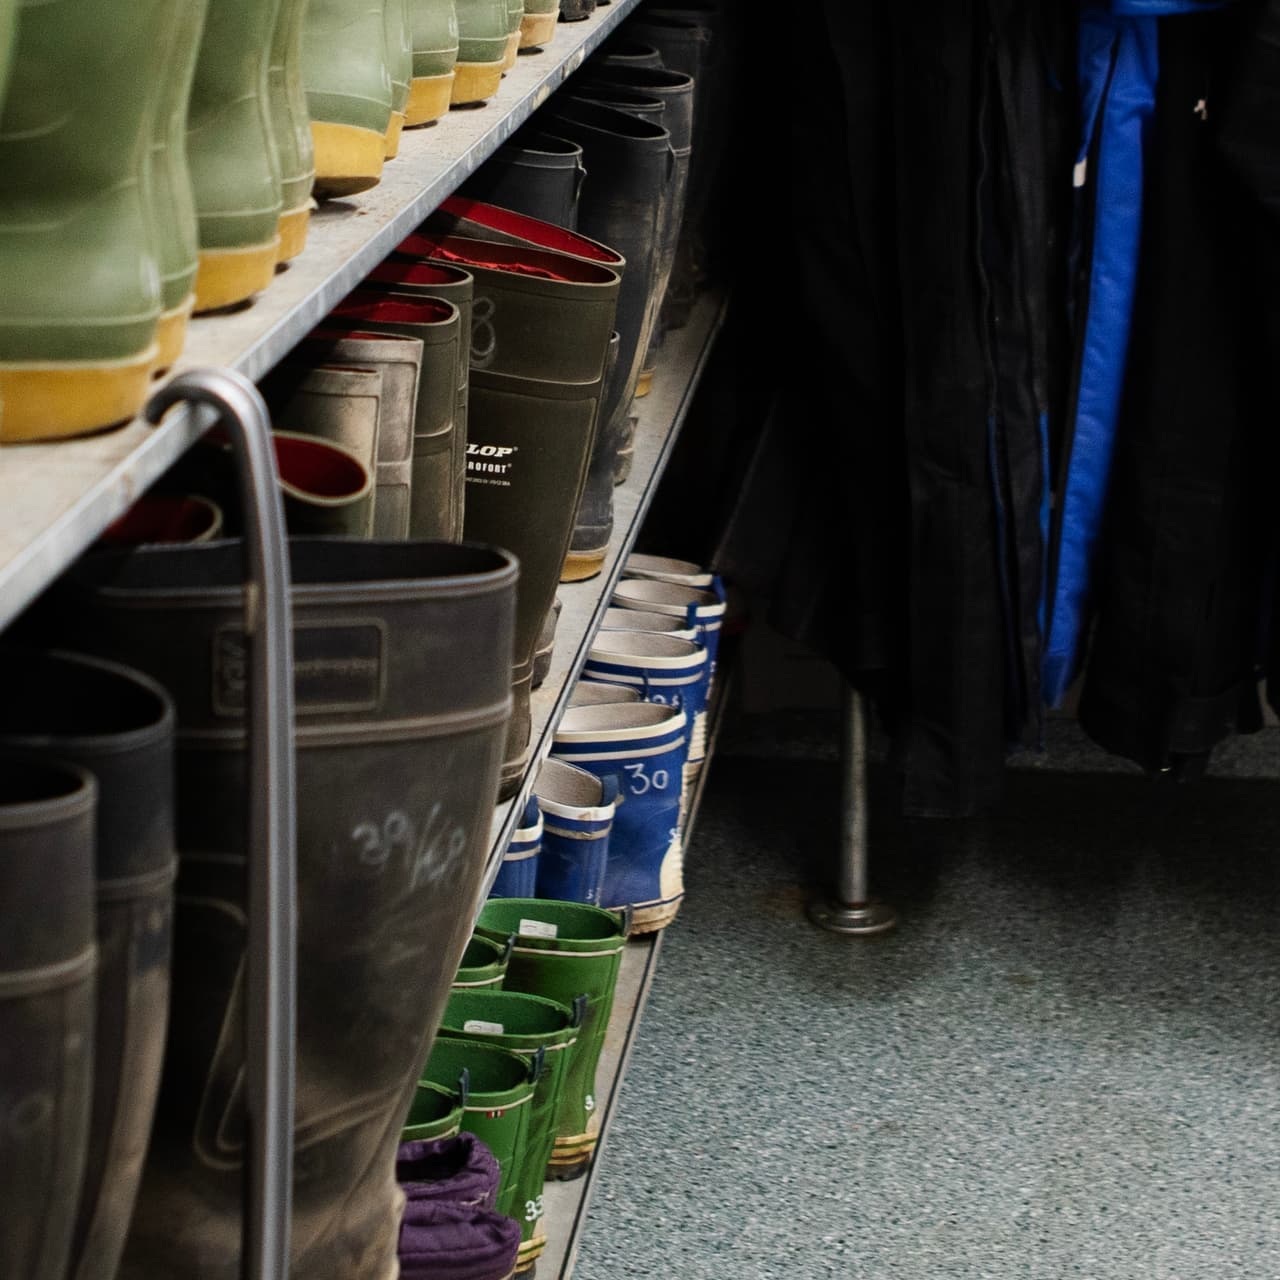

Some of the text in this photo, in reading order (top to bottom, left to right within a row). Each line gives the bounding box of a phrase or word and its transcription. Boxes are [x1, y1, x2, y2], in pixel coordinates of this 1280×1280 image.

[465, 443, 513, 457] LOP
[467, 461, 507, 473] ROFORT
[624, 763, 669, 795] 30
